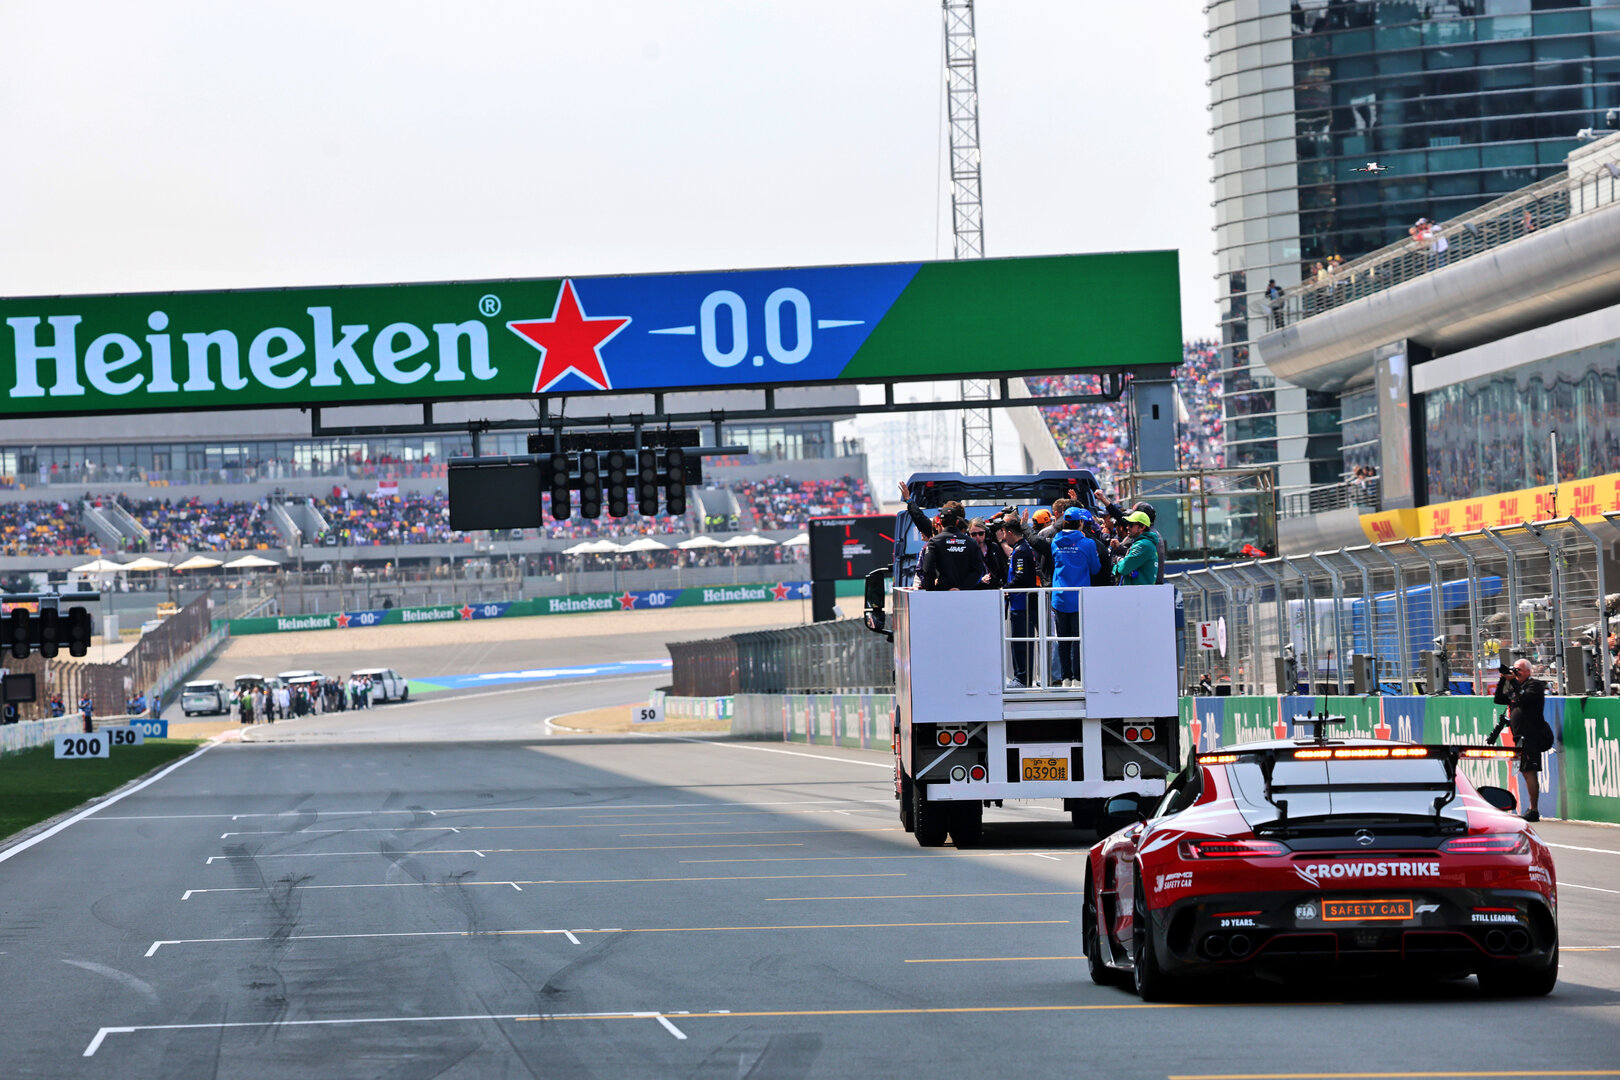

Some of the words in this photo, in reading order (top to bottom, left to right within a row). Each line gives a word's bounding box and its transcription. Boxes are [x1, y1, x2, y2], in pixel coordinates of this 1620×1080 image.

[6, 305, 499, 398] Heineken
[700, 286, 814, 368] 0.0
[703, 587, 766, 603] Heineken
[549, 596, 613, 612] Heineken
[402, 609, 454, 622] Heineken
[277, 617, 331, 631] Heineken
[641, 708, 656, 720] 50
[136, 722, 162, 736] 00
[107, 729, 136, 744] 150
[63, 738, 101, 756] 200
[1306, 862, 1441, 878] CROWDSTRIKE
[1181, 879, 1193, 887] CAR
[1295, 906, 1316, 918] FIA
[1330, 905, 1376, 916] SAFETY
[1381, 904, 1406, 914] CAR
[1220, 919, 1230, 927] 30
[1231, 918, 1256, 927] YEARS.
